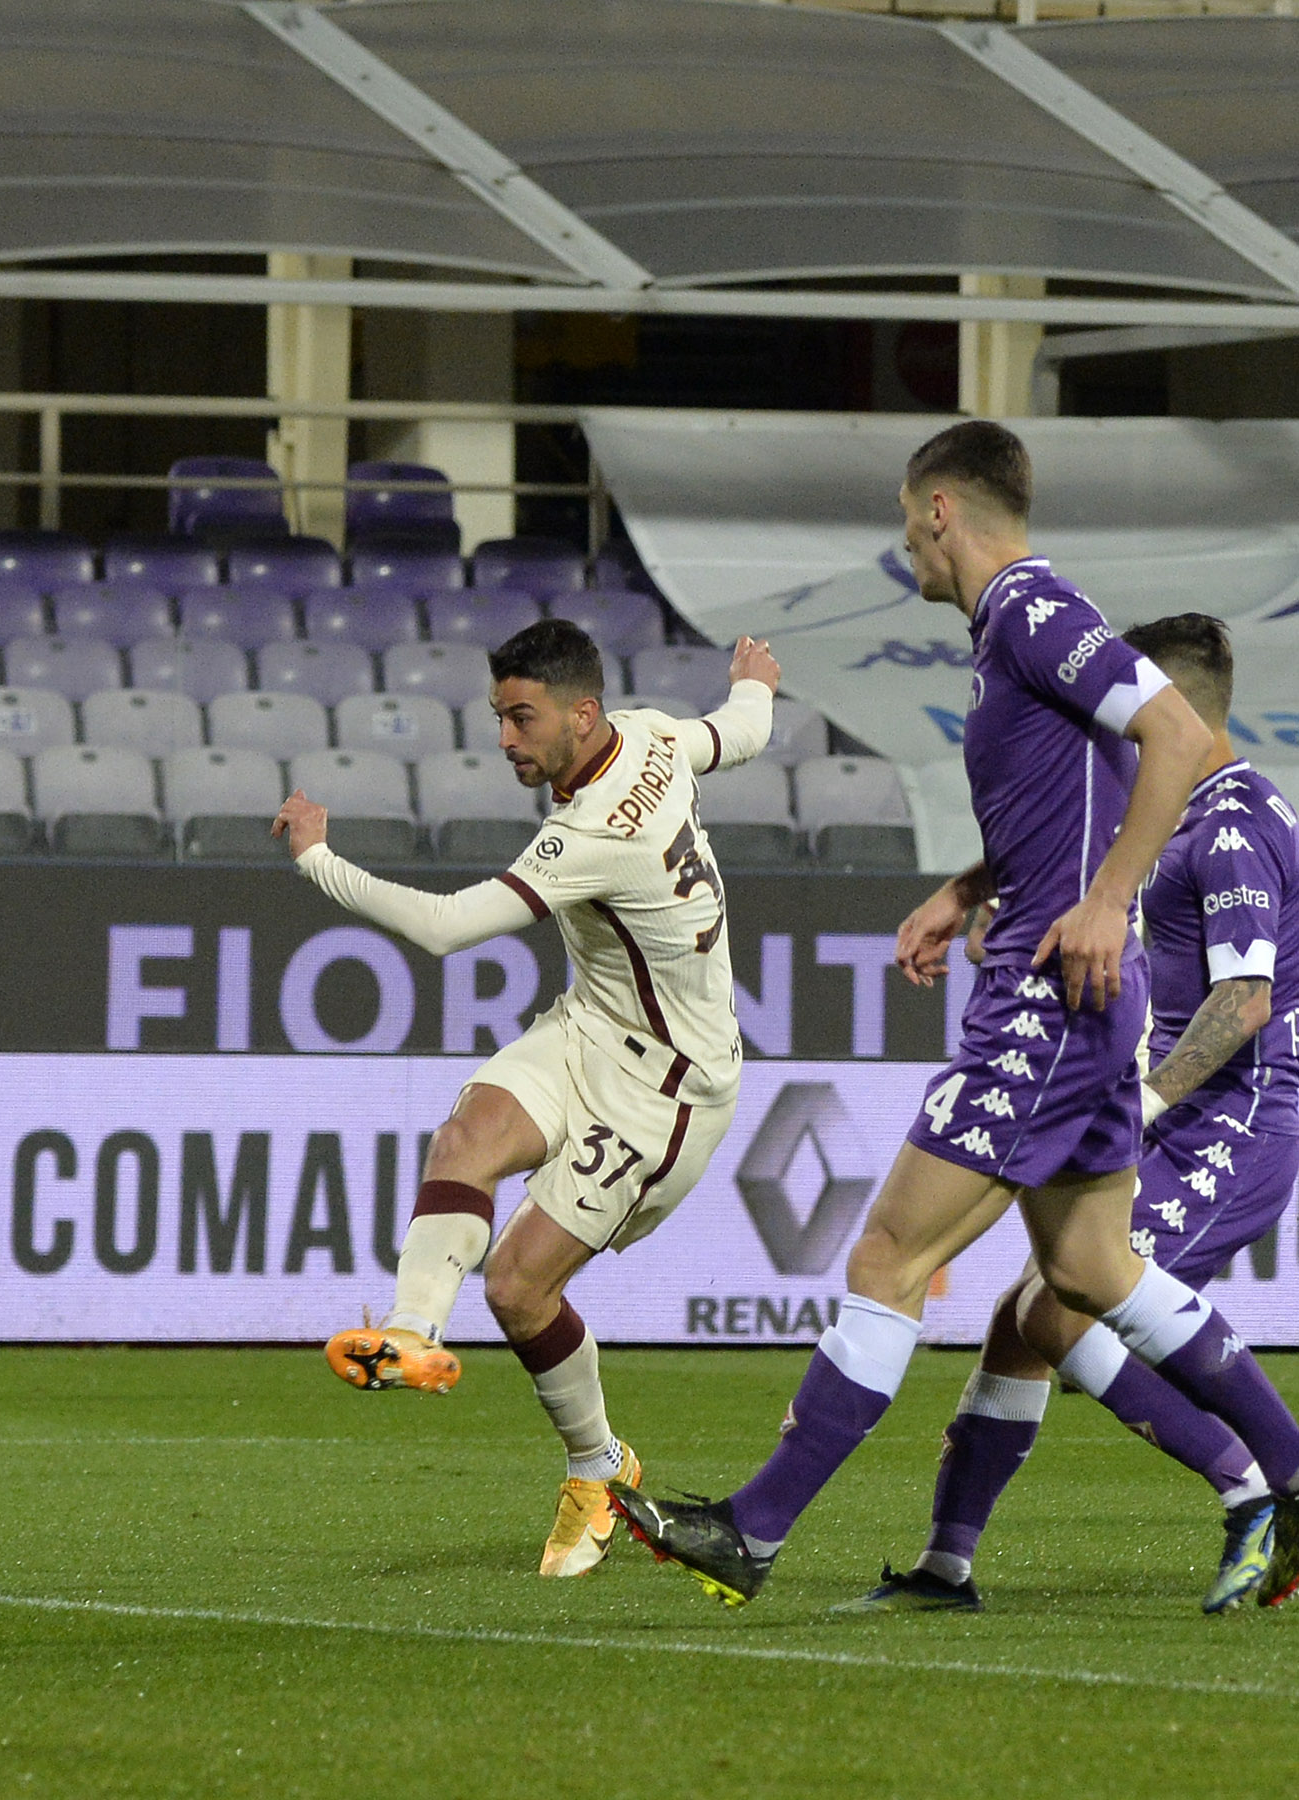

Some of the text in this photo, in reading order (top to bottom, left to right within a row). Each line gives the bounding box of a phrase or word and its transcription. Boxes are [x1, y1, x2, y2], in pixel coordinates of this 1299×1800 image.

[1219, 884, 1270, 910] estra
[924, 1072, 964, 1134] 4
[571, 1124, 645, 1188] 37
